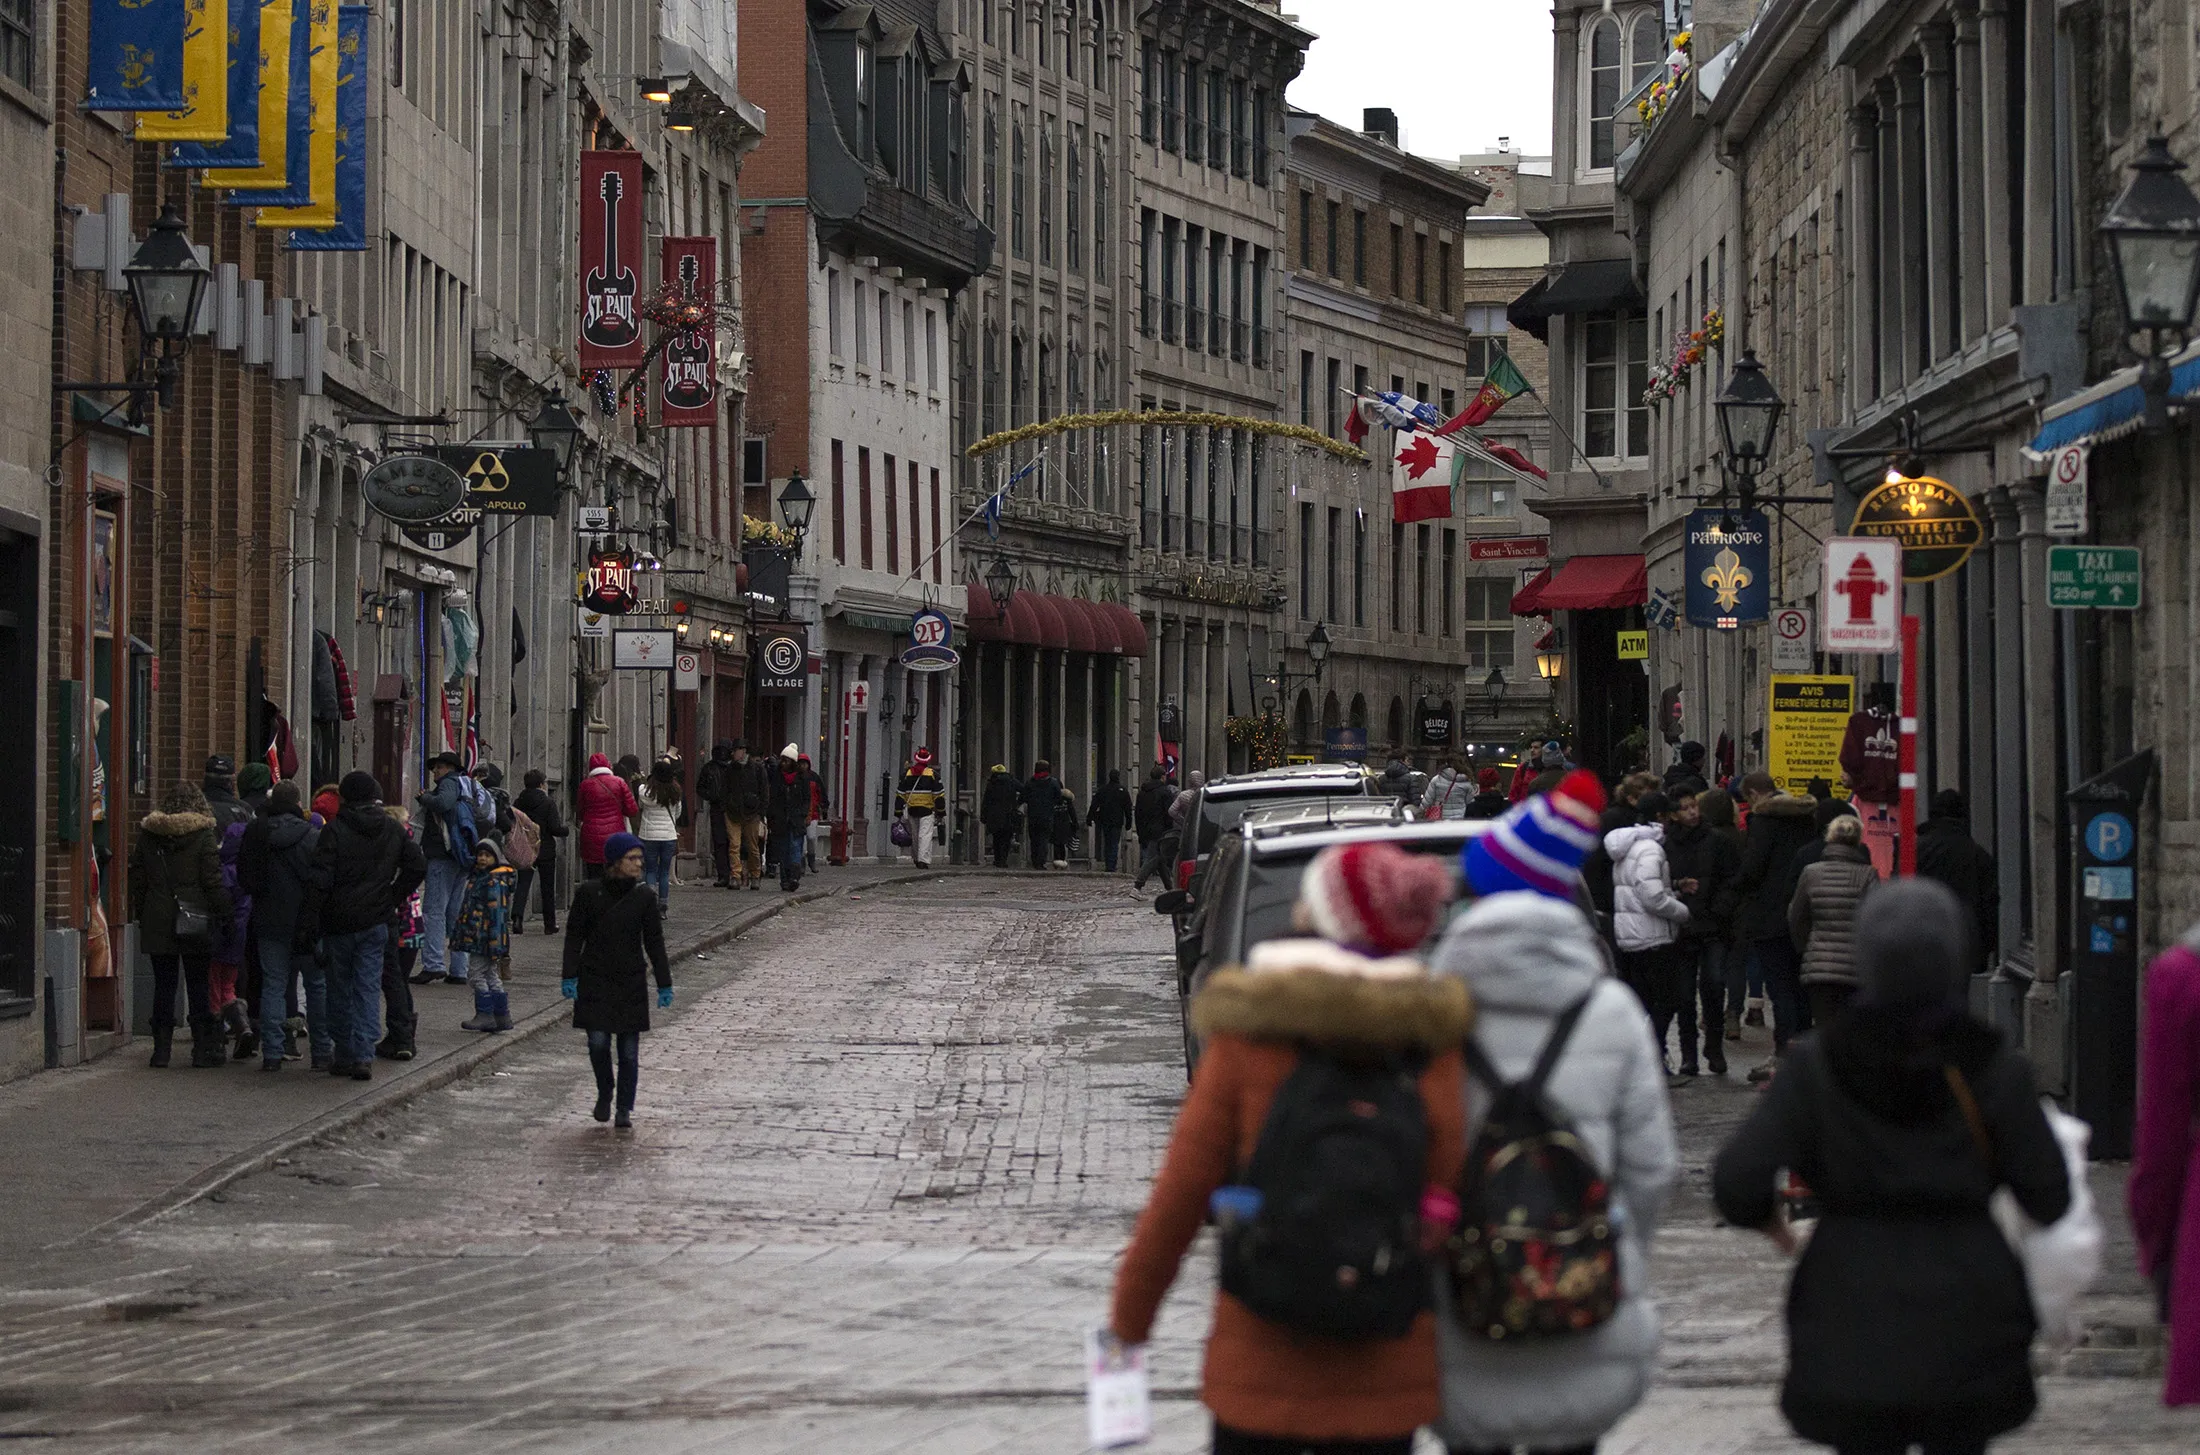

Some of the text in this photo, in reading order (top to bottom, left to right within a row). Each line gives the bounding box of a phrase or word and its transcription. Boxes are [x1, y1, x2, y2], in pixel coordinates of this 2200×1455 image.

[588, 294, 635, 330] ST. PAUL
[668, 362, 709, 393] ST. PAUL
[1869, 483, 1956, 512] RESTO BAR
[1865, 522, 1967, 535] MONTREAL
[1691, 532, 1762, 544] PATRIOTE
[1902, 533, 1958, 545] UTINE
[1479, 546, 1538, 557] Saint-Vincent
[2076, 552, 2115, 569] TAXI
[587, 567, 632, 599] ST. PAUL
[2053, 586, 2080, 600] 250
[914, 620, 945, 644] 2P
[1620, 638, 1646, 653] ATM
[761, 678, 804, 688] LA CAGE
[1800, 686, 1824, 696] AVIS
[1775, 698, 1848, 709] FERMETURE DE RUE
[1424, 717, 1449, 729] DÉLICES
